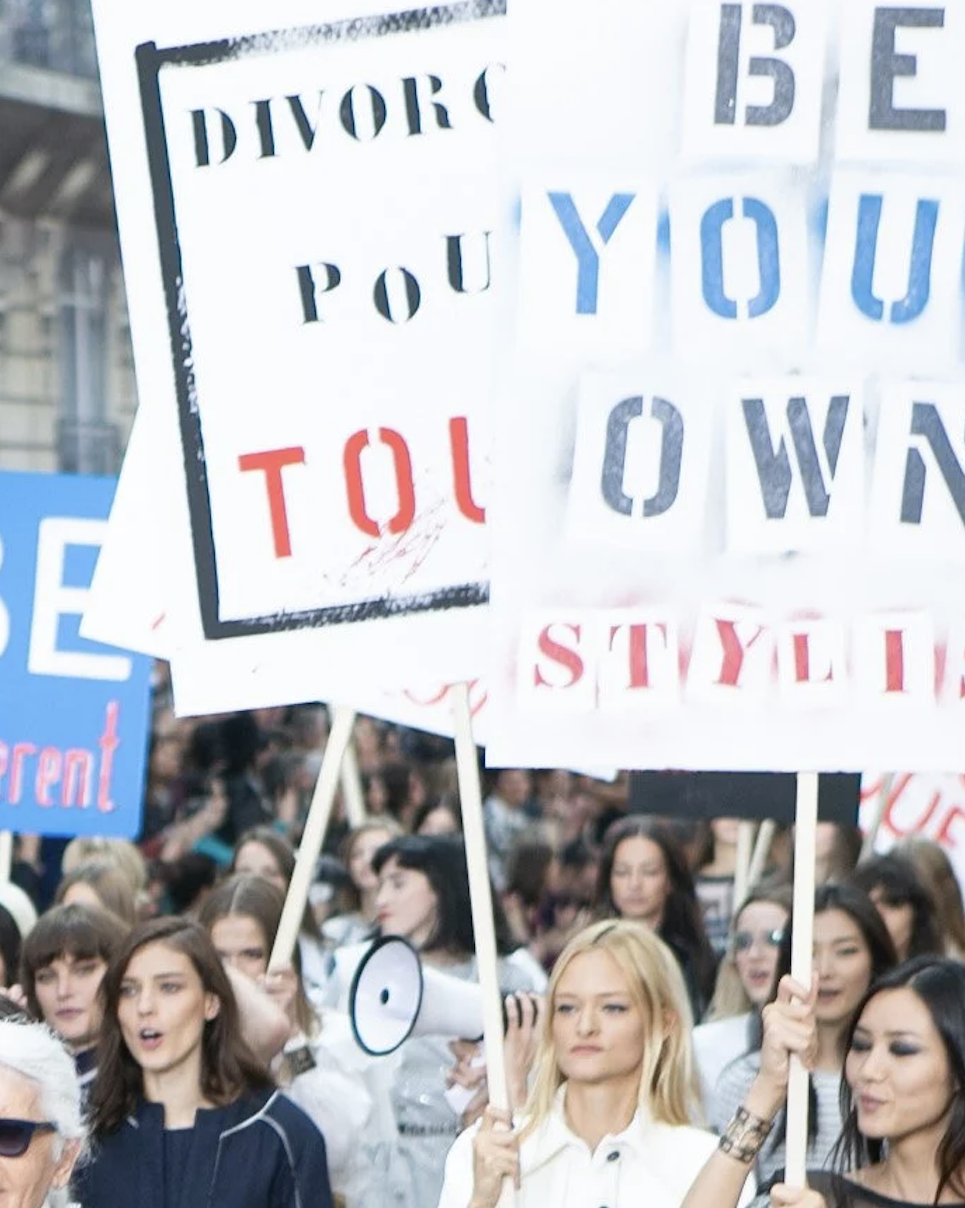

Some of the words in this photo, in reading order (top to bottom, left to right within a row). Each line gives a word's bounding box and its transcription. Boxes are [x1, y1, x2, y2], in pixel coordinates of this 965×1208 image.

[714, 3, 947, 131] BE
[600, 394, 965, 526] OWN
[534, 618, 965, 699] STYLI
